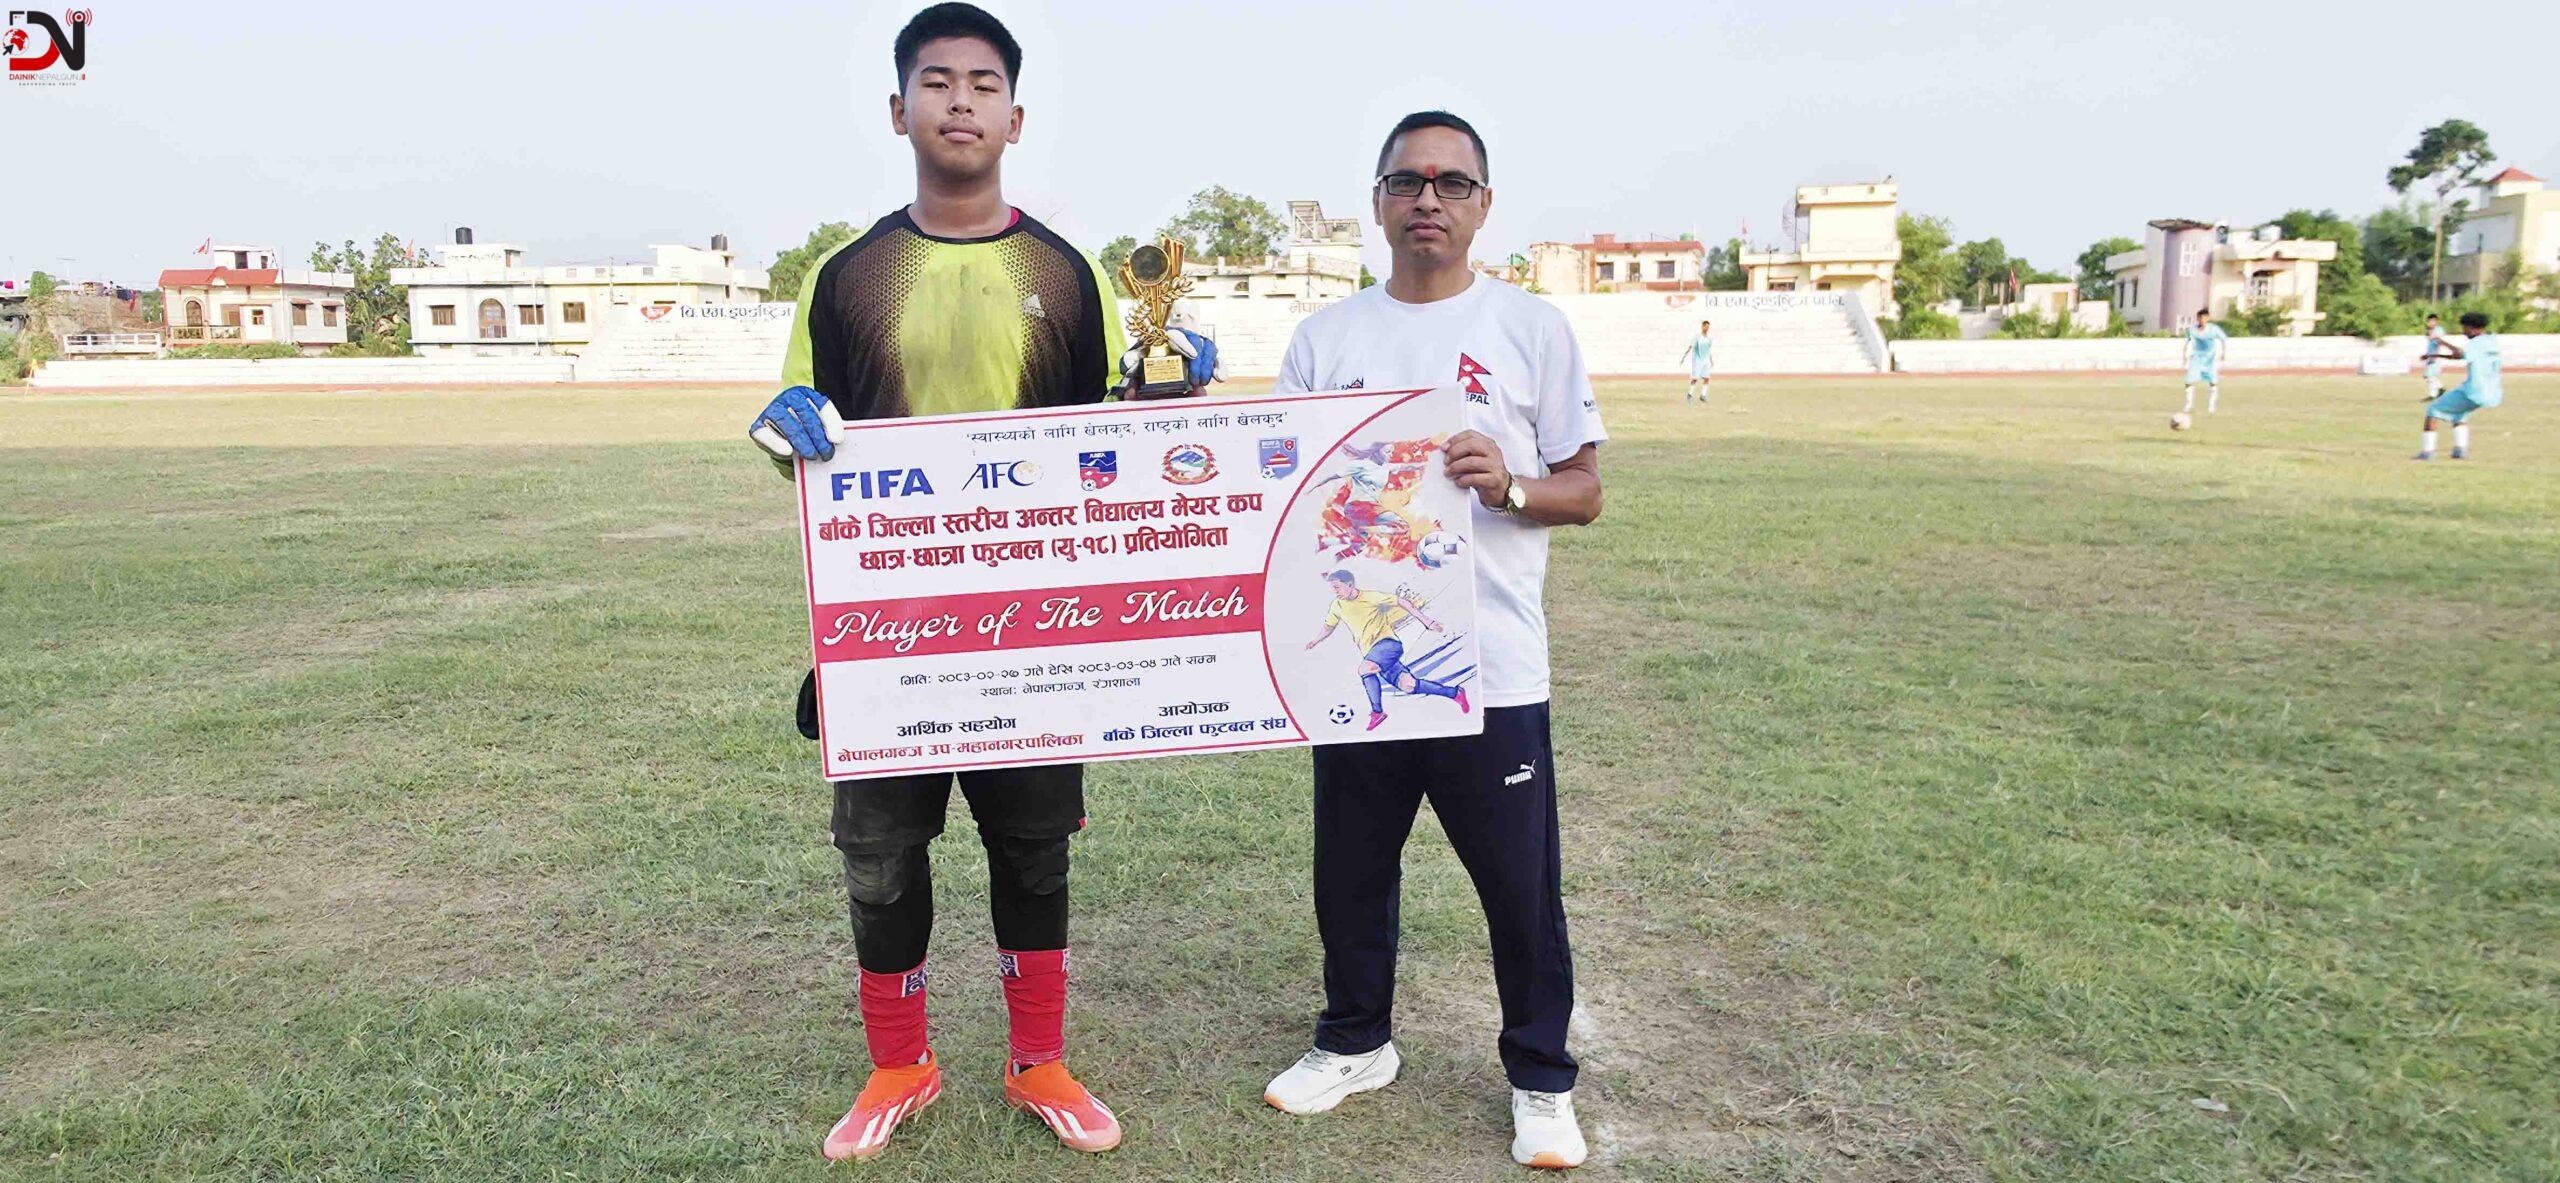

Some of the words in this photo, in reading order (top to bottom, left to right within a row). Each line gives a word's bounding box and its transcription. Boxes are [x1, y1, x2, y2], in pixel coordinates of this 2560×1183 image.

[1044, 423, 1076, 438] लागि
[1197, 415, 1229, 429] लागि
[831, 468, 935, 501] FIFA
[961, 460, 1035, 491] AFC
[867, 512, 936, 539] जिल्ला
[941, 506, 1009, 535] स्तरीय
[1015, 506, 1079, 529] अन्तर
[1084, 498, 1166, 525] विद्यालय
[1171, 492, 1221, 517] मेयर
[1226, 493, 1264, 514] कप
[971, 540, 1045, 568] फुटबल
[1123, 523, 1229, 556] प्रतियोगिता
[822, 609, 965, 654] Player
[976, 601, 1024, 646] of
[1034, 596, 1103, 630] The
[1120, 585, 1250, 625] Match
[1158, 701, 1231, 717] आयोजक
[896, 721, 954, 738] आर्थिक
[959, 715, 1017, 734] सहयोग
[1141, 725, 1195, 740] जिल्ला
[1199, 720, 1255, 738] फुटबल
[1260, 717, 1288, 731] संघ
